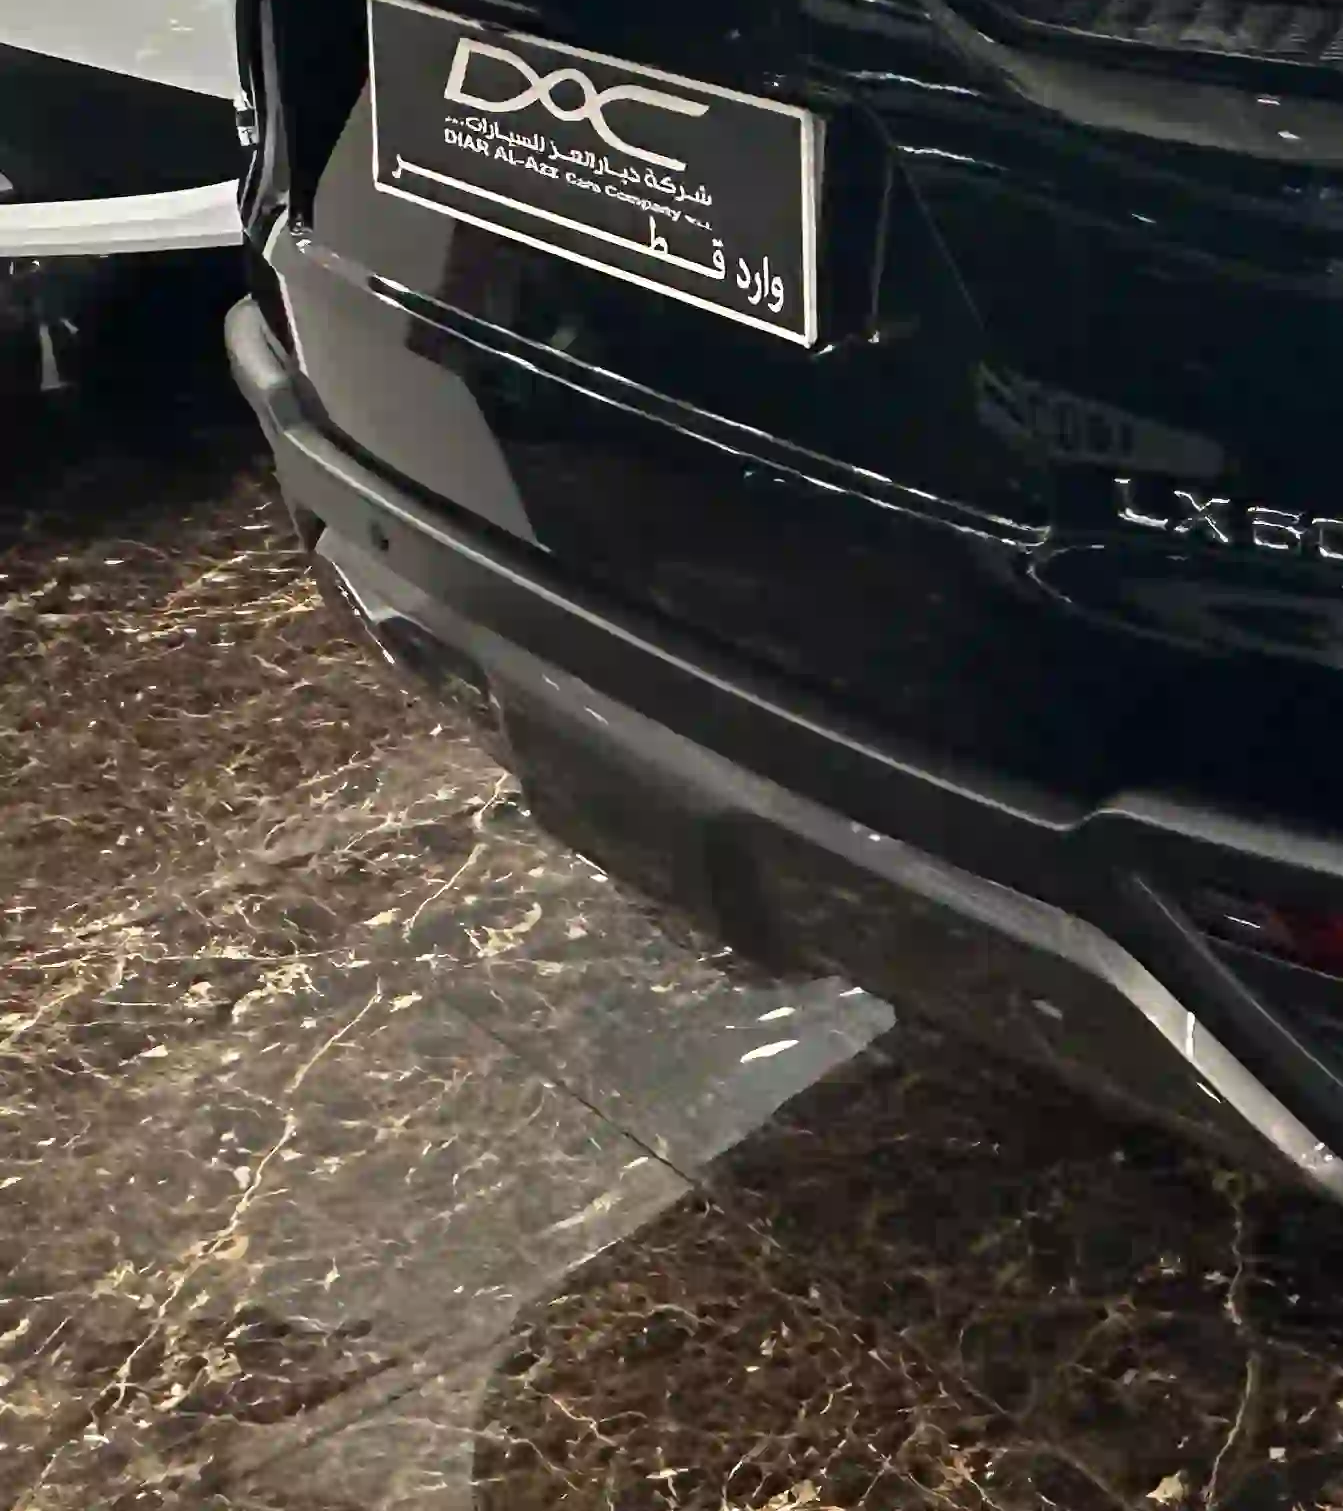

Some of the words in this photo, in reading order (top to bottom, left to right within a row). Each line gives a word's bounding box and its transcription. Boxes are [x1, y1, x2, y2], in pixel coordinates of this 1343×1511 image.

[444, 128, 490, 157] DIAR
[643, 167, 713, 206] شركة
[736, 256, 785, 313] وارد
